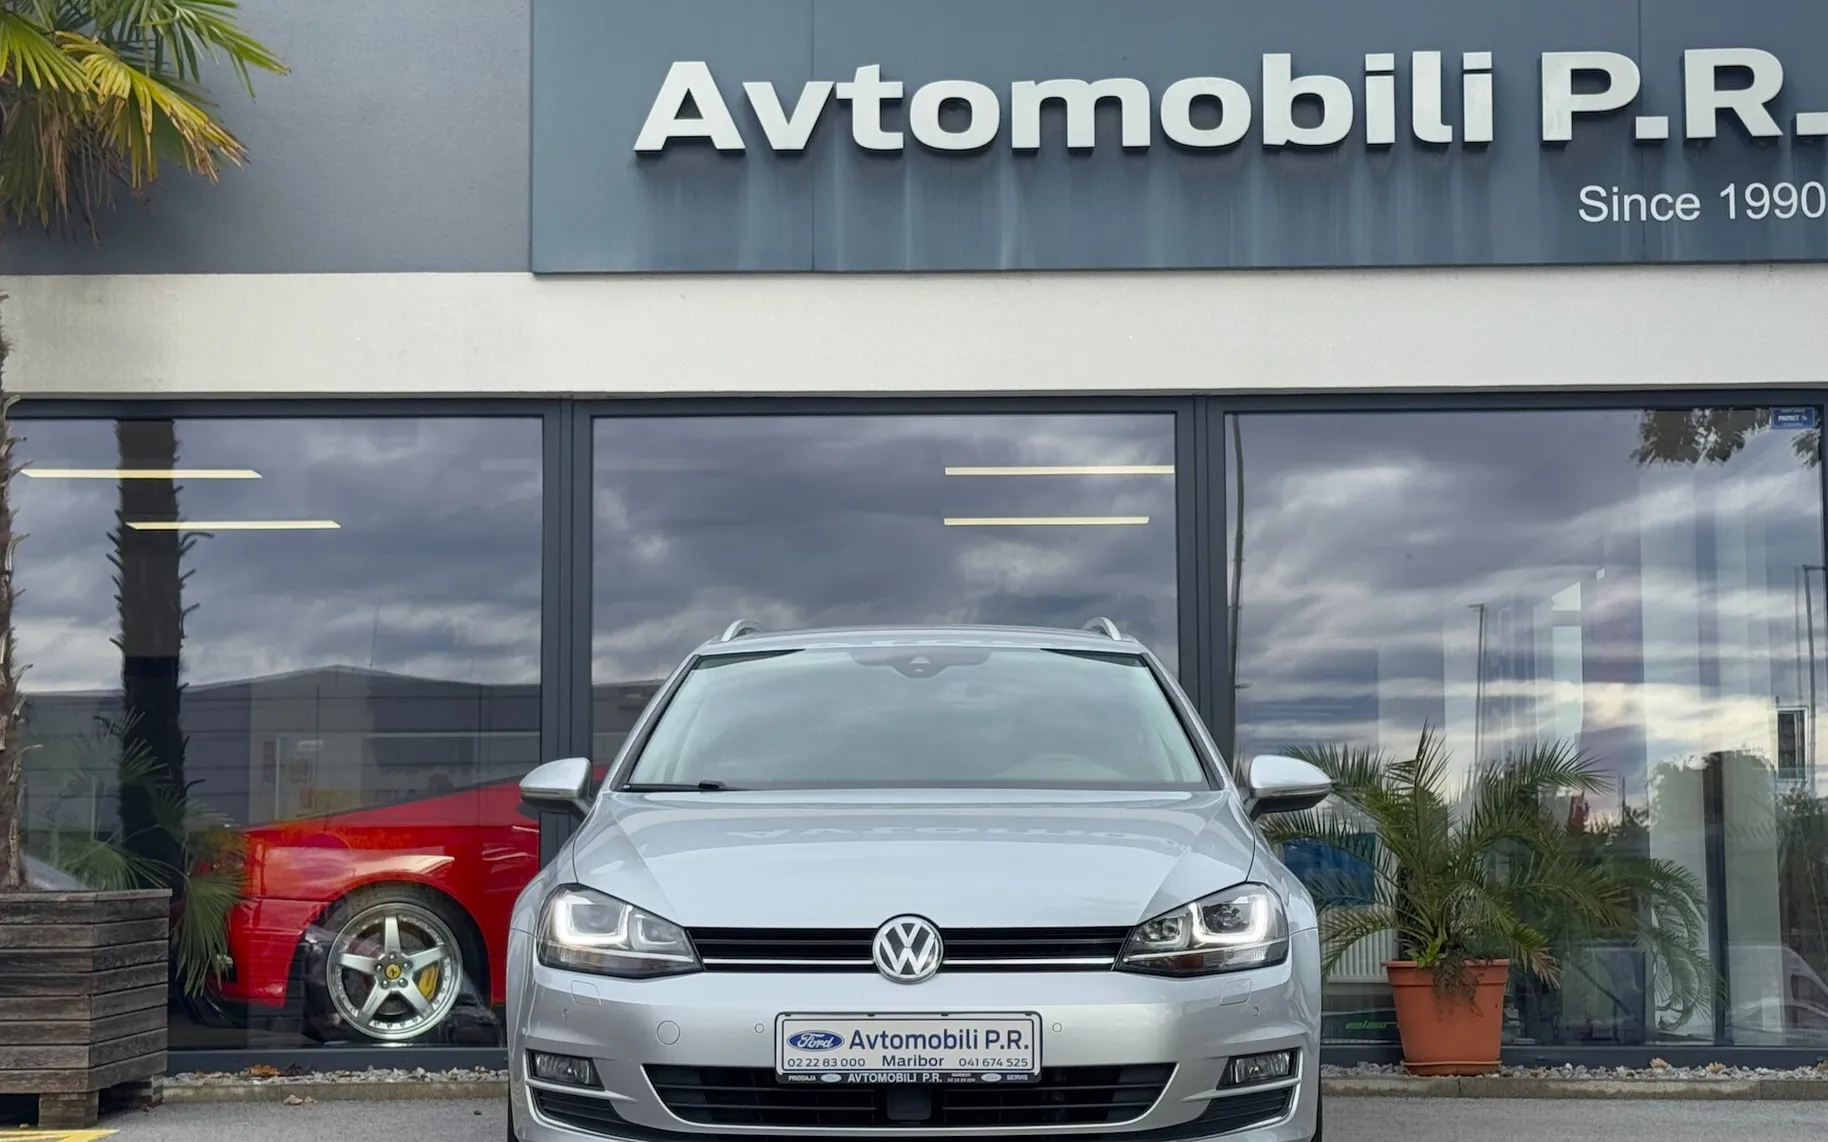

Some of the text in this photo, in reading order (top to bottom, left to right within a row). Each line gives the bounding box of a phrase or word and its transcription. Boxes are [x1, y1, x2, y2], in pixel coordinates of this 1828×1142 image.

[633, 47, 1828, 152] Avtomobili P.R.
[1578, 181, 1827, 222] Since 1990
[796, 1029, 1029, 1050] Ford Avtomobili P.R.
[881, 1055, 944, 1067] Maribor
[982, 1058, 1004, 1068] 674
[1006, 1058, 1028, 1068] 525
[788, 1074, 816, 1082] PRODAJA
[847, 1073, 917, 1083] AVTOMOBILI
[922, 1073, 943, 1083] P.R.
